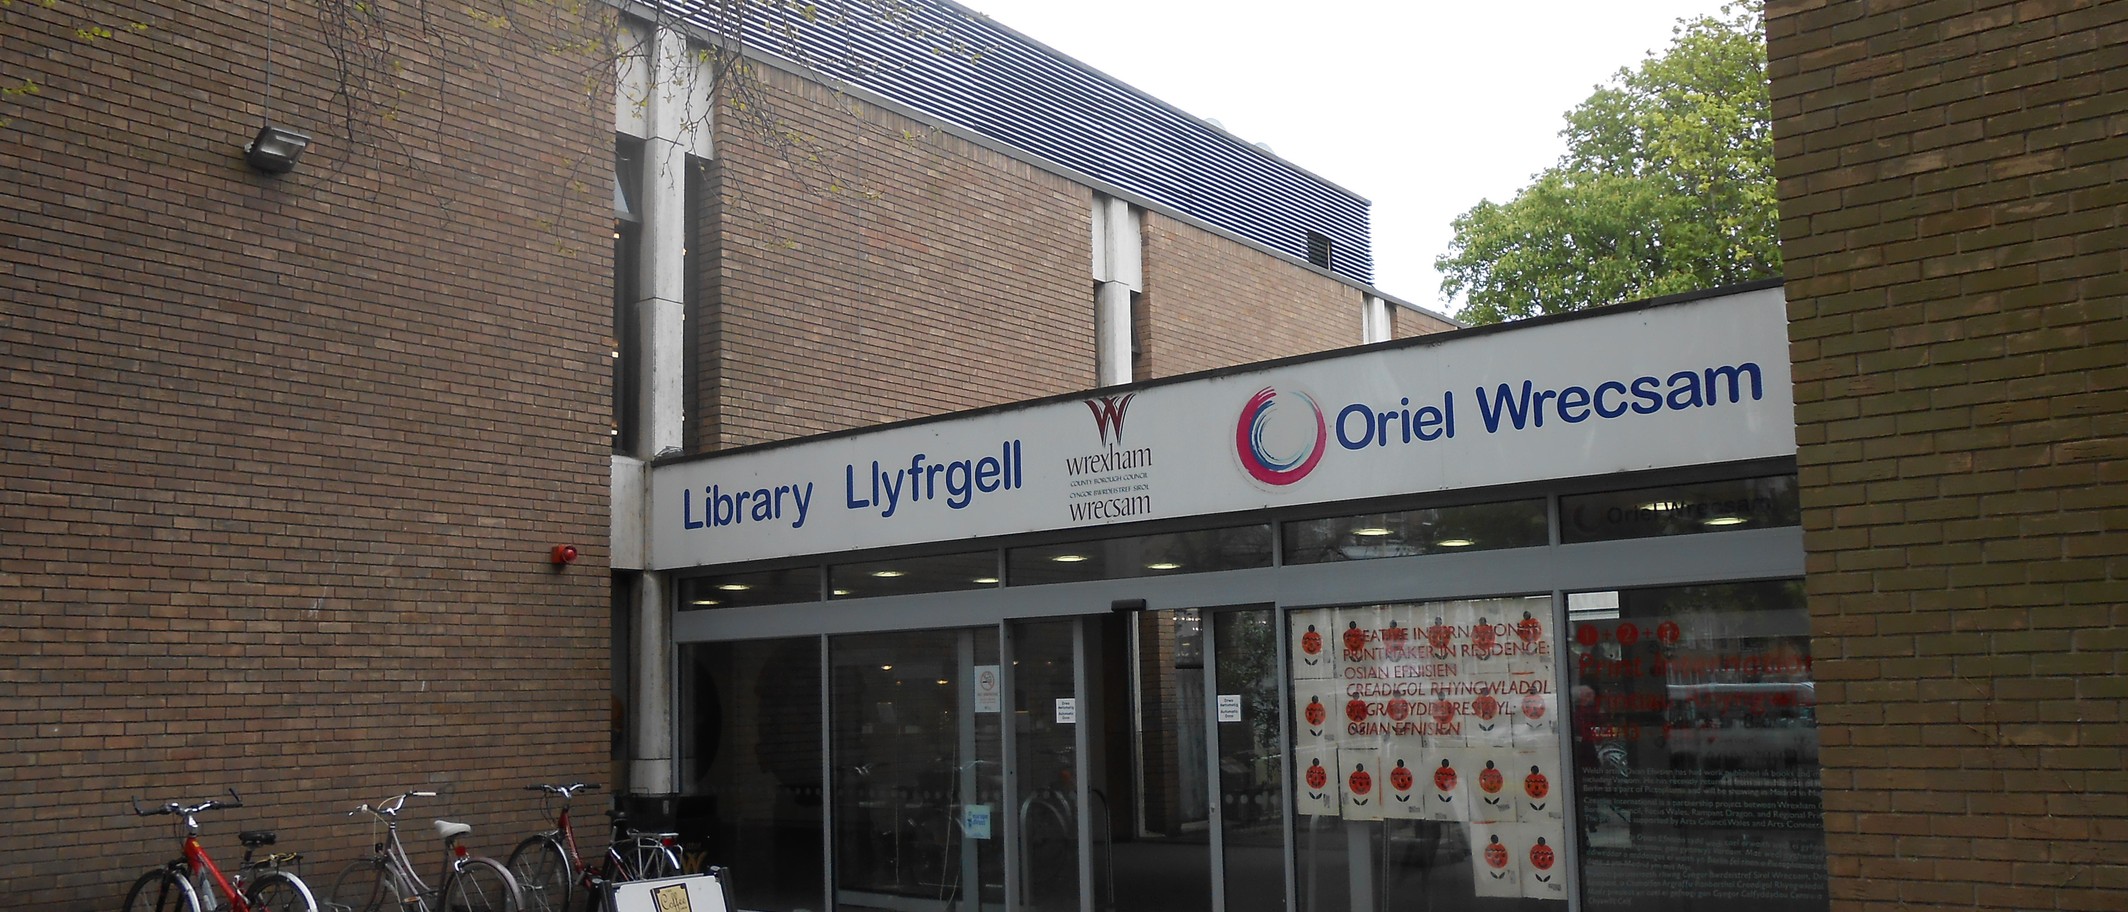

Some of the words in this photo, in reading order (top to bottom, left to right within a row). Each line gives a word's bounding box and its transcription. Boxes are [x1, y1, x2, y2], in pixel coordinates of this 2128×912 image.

[1335, 390, 1455, 452] Oriel
[1475, 361, 1764, 435] Wrecsam
[1065, 442, 1153, 476] wrexham
[683, 481, 814, 530] Library
[846, 439, 1023, 519] Llyfrgell
[1070, 479, 1092, 488] COUNTY
[1094, 475, 1122, 485] BOROUGH
[1123, 472, 1148, 481] COUNCIL
[1069, 494, 1151, 521] wrecsam
[1343, 627, 1409, 643] CEATIE
[1343, 645, 1435, 662] PRINTMAKER
[1440, 643, 1456, 658] IN
[1462, 640, 1550, 657] RESIDENCE:
[1344, 665, 1390, 680] OSIAN
[1394, 663, 1457, 679] EFNISIEN
[1346, 682, 1426, 698] CREADIGOL
[1430, 680, 1551, 697] RHYNGWLADOL
[1347, 721, 1391, 736] OSIAN
[1395, 720, 1461, 736] EFNISIEN
